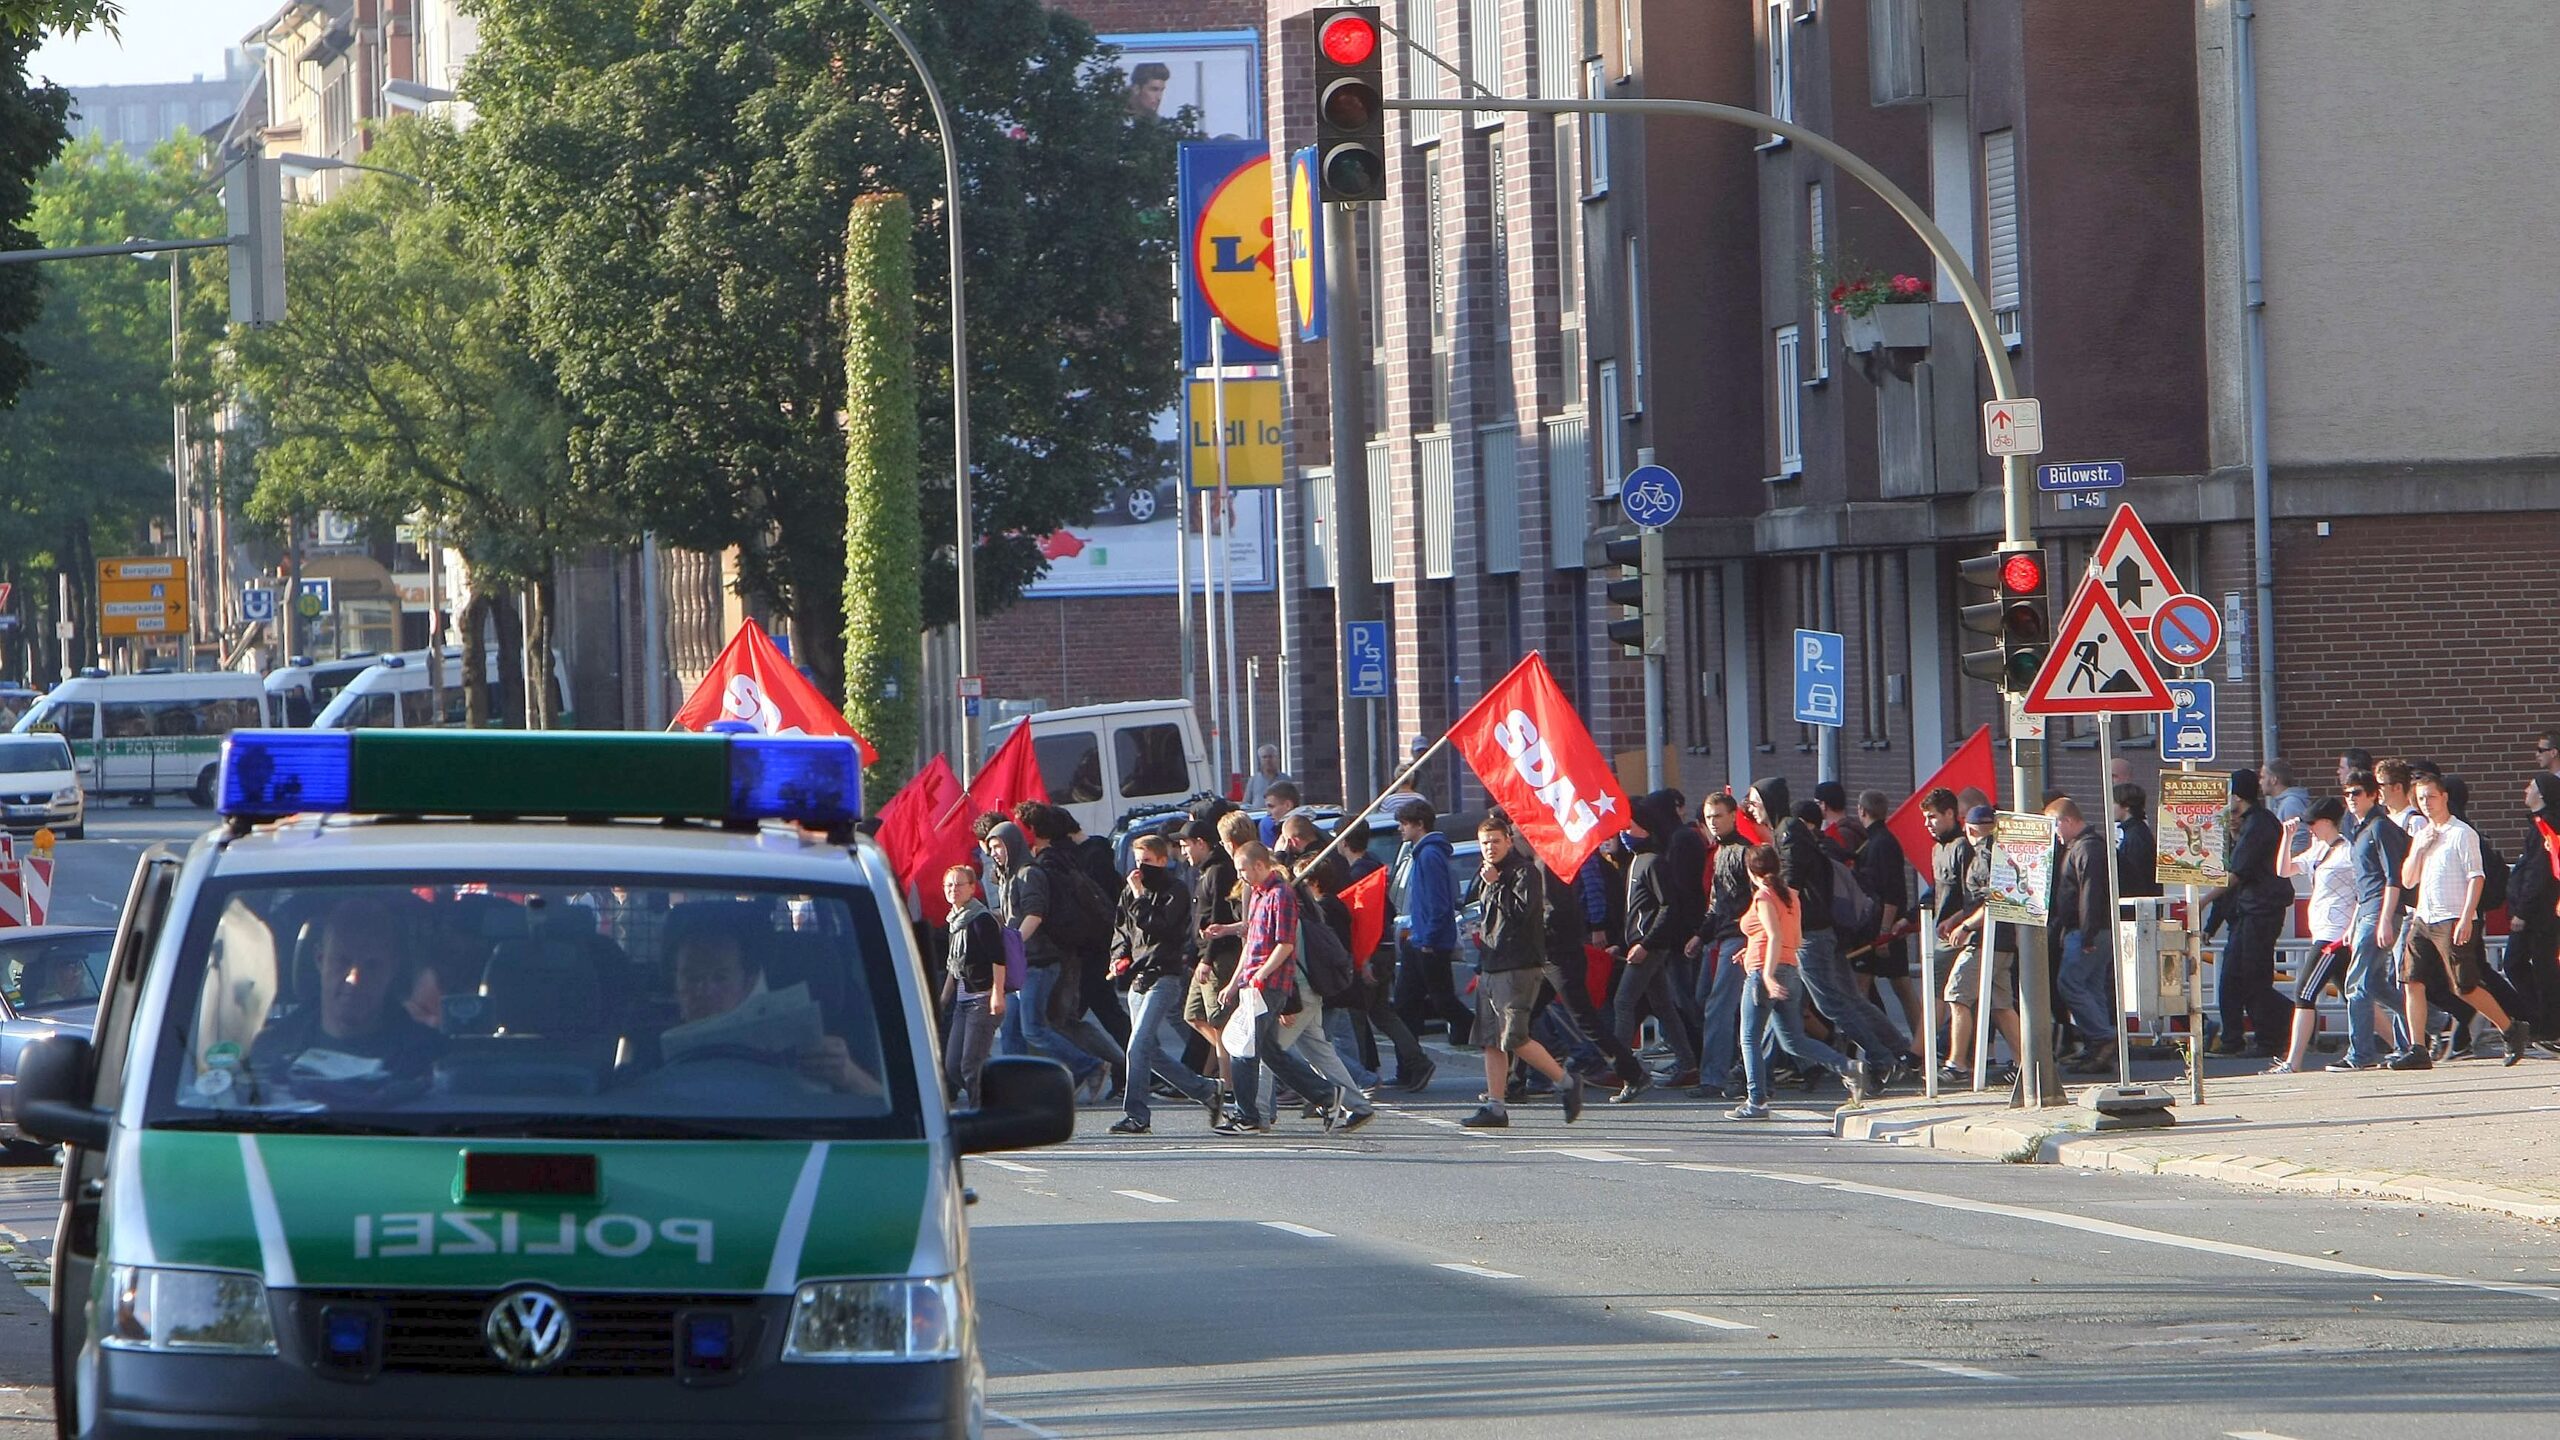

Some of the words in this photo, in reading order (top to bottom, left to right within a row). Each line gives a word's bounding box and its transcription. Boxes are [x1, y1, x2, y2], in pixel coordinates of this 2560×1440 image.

[2049, 466, 2112, 484] Bülowstr.
[2072, 492, 2100, 507] 1-45
[245, 592, 269, 617] U
[138, 619, 163, 628] Hafen
[1353, 627, 1369, 656] P
[1802, 637, 1823, 672] P
[126, 740, 177, 754] POLIZEI
[1494, 709, 1600, 843] SDAJ
[2164, 782, 2179, 790] SA
[2181, 781, 2223, 790] 03.09.11
